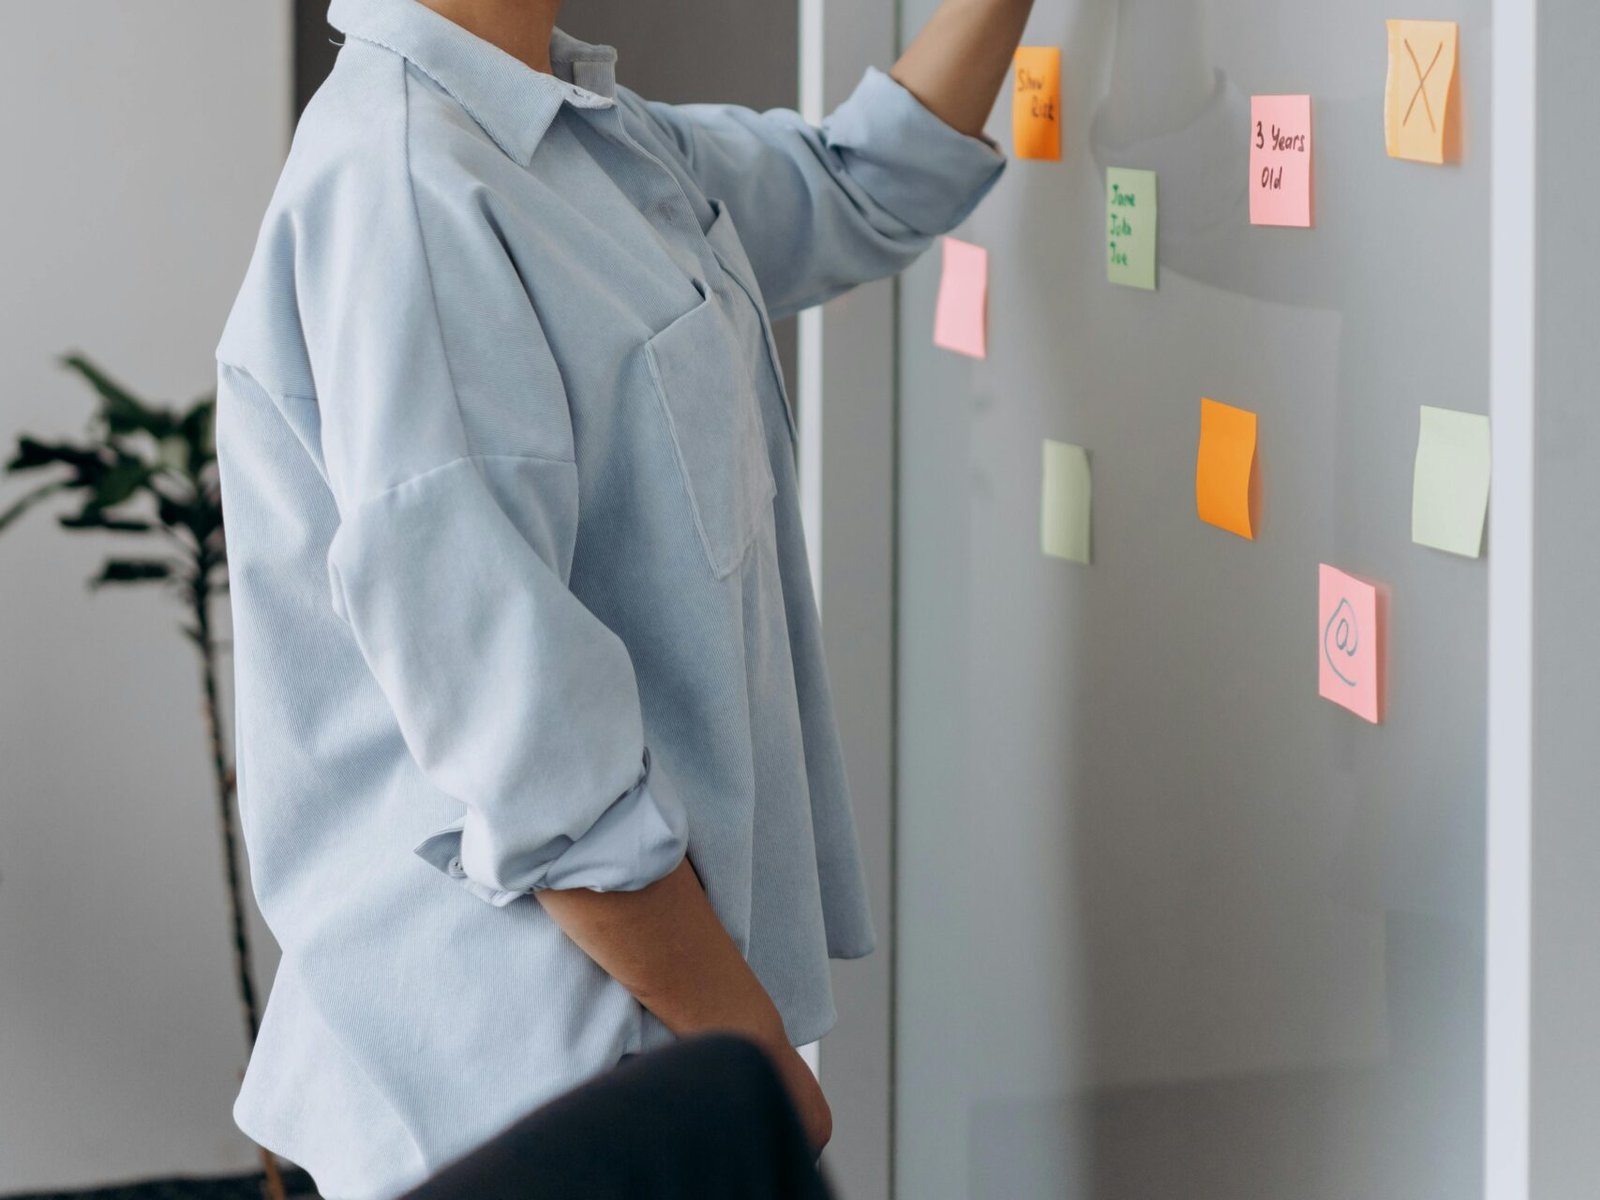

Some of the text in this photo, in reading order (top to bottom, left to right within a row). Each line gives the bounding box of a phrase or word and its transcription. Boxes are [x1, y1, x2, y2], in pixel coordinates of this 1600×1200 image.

[1255, 120, 1306, 152] 3 Years
[1261, 166, 1283, 191] Old
